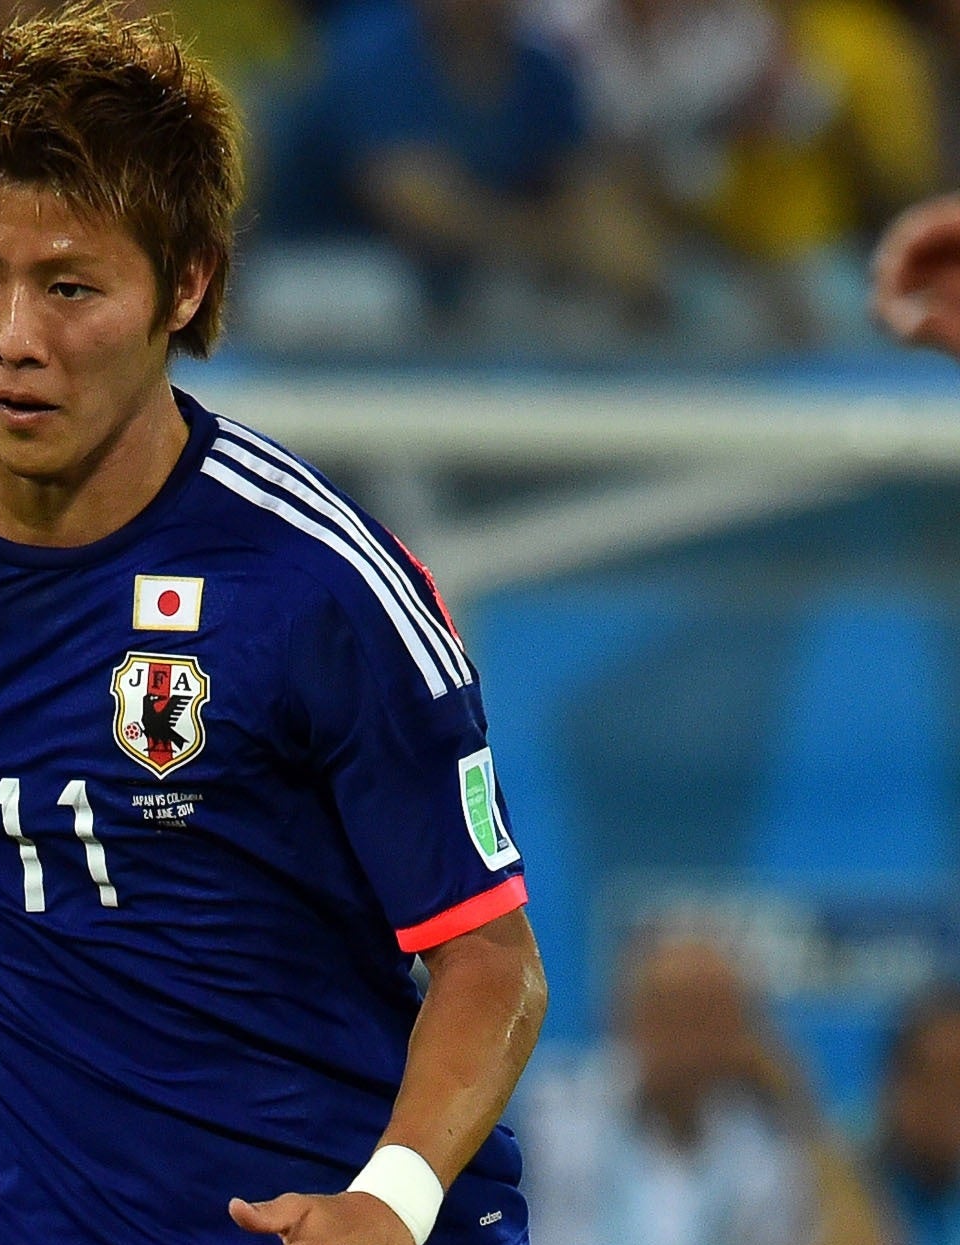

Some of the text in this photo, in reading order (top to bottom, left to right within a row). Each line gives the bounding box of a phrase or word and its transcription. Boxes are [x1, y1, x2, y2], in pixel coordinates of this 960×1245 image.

[129, 669, 192, 691] JFA
[132, 794, 154, 806] JAPAN
[155, 794, 166, 806] VS
[143, 809, 154, 819] 24
[177, 803, 194, 817] 2014
